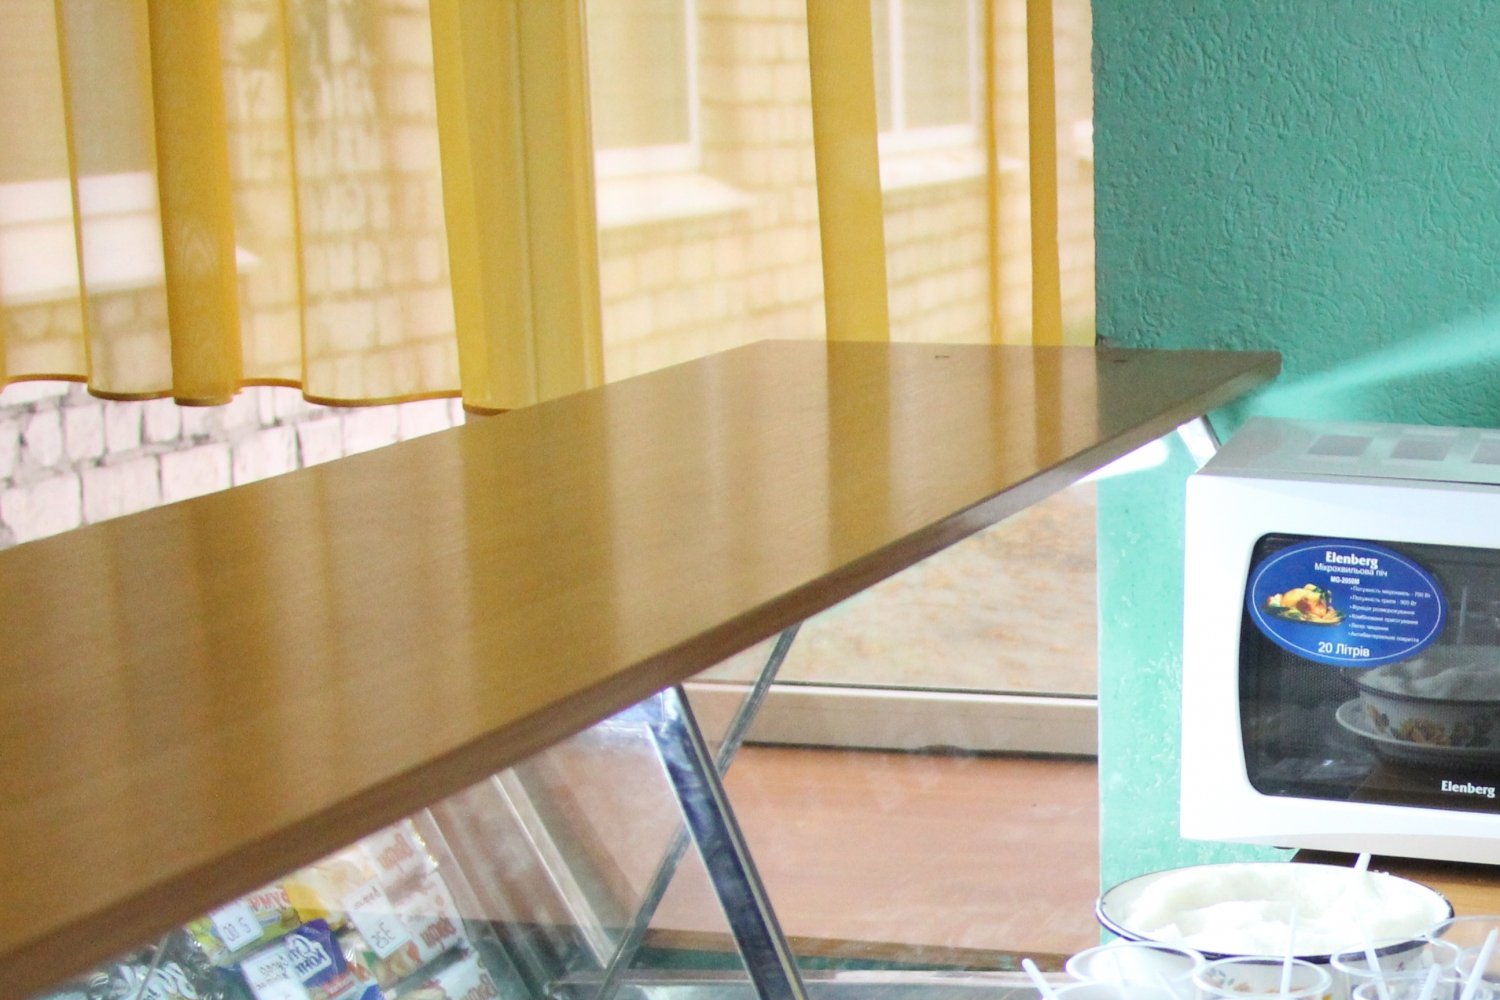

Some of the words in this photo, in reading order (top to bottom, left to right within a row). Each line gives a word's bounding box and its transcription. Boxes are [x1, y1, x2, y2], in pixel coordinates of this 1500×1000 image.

[1326, 551, 1378, 569] Elenberg
[1318, 641, 1333, 653] 20
[1336, 643, 1370, 658] Літрів
[1441, 780, 1496, 798] Elenberg
